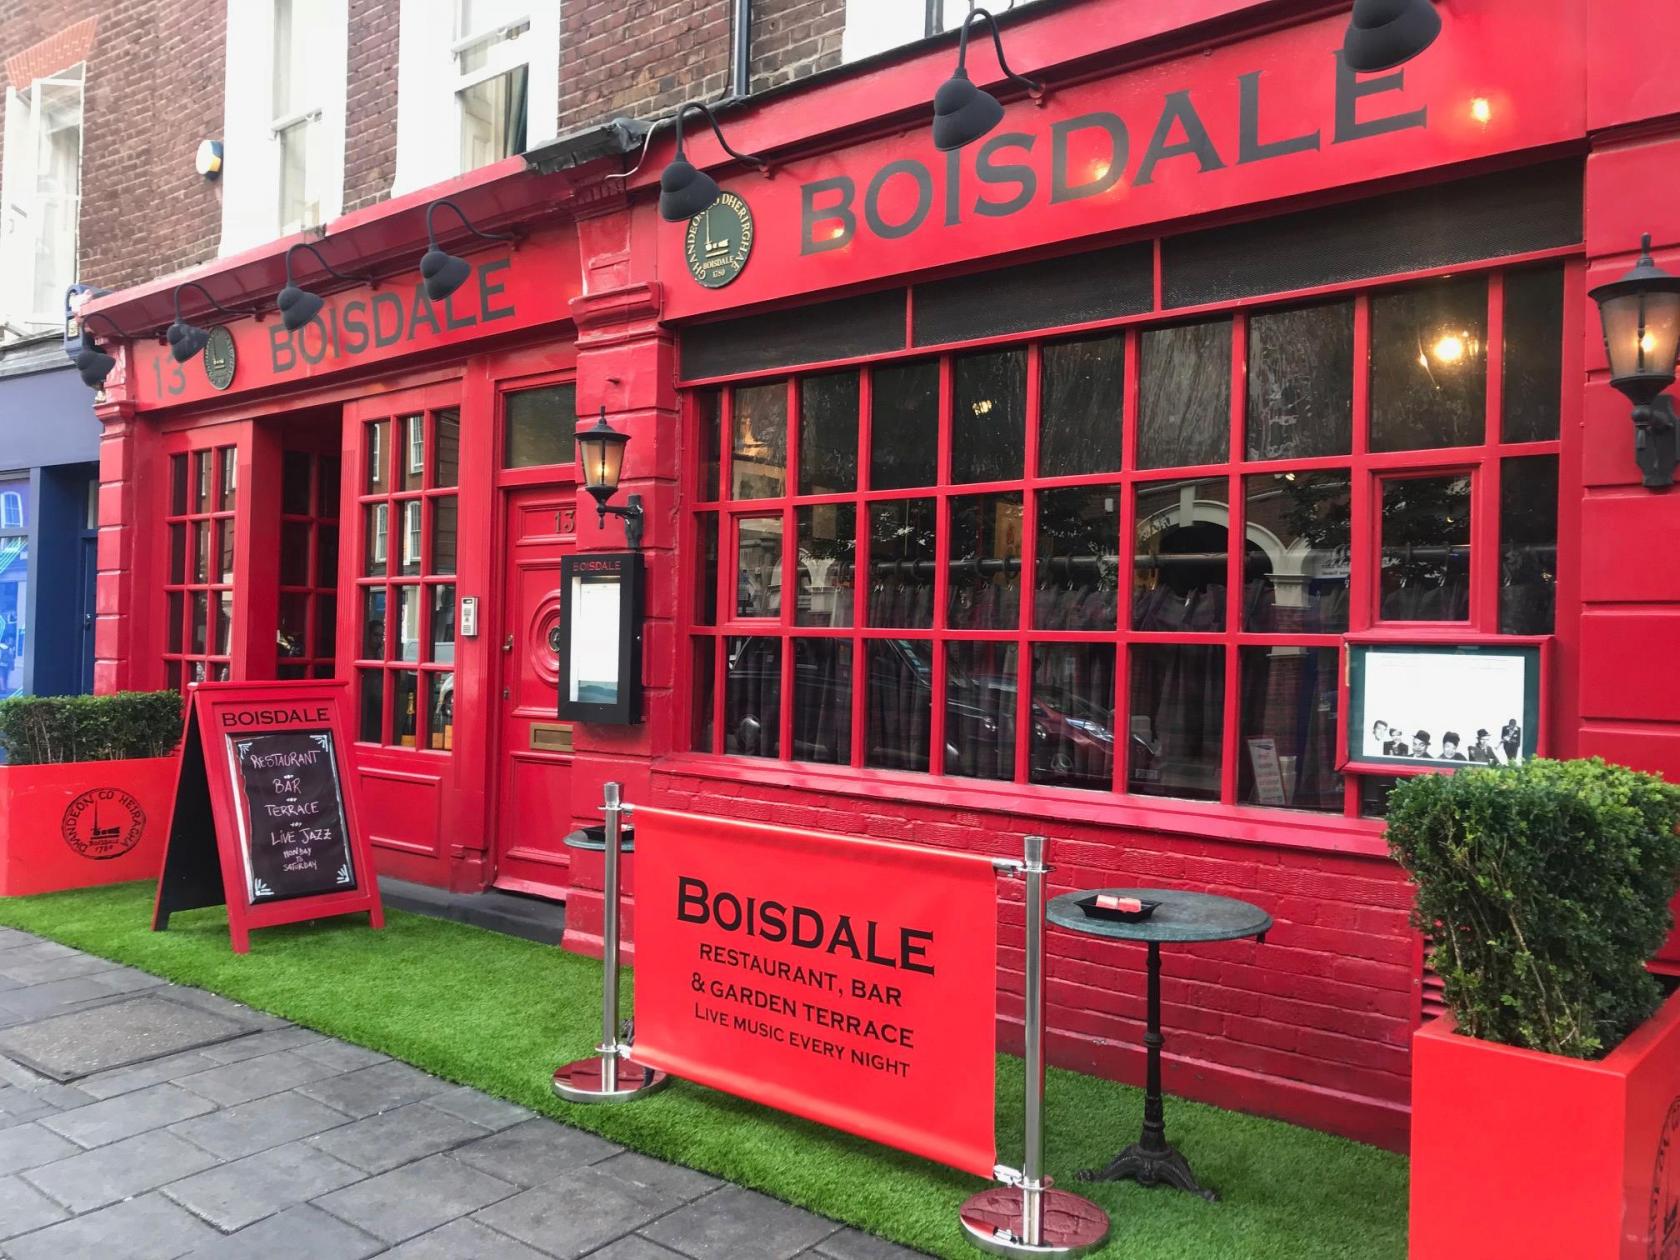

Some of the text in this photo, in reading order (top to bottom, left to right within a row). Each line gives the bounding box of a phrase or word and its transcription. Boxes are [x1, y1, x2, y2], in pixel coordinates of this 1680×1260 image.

[801, 48, 1429, 256] BOISDALE
[269, 258, 515, 374] BOISDALE
[152, 347, 186, 399] 13
[554, 510, 576, 534] 13
[572, 560, 622, 572] BOISDALE
[222, 707, 330, 727] BOISDALE
[250, 750, 321, 769] RESTAURANT
[272, 777, 302, 794] BAR
[264, 801, 319, 817] TERRACE
[299, 828, 332, 844] JAZZ
[283, 847, 312, 858] MONDAY
[283, 860, 317, 872] SATURDAY
[676, 875, 936, 976] BOISDALE
[700, 943, 902, 1007] RESTAURANT, BAR
[691, 971, 914, 1049] & GARDEN TERRACE
[694, 1001, 911, 1078] LIVE MUSIC EVERY NIGHT
